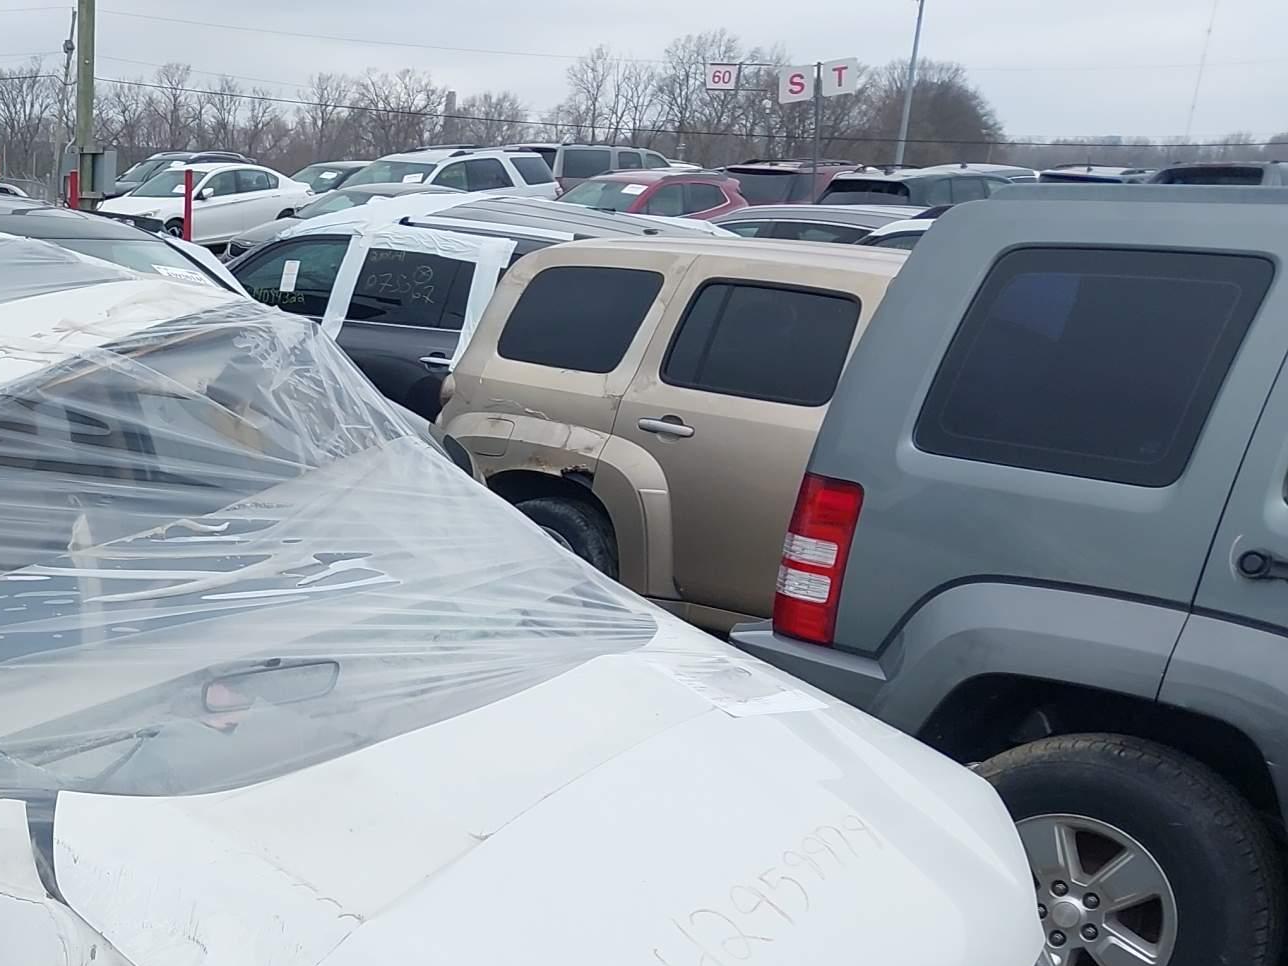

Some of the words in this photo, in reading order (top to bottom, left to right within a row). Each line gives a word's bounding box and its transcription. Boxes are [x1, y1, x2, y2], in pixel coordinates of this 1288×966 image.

[711, 70, 732, 85] 60
[788, 73, 806, 95] S
[831, 66, 849, 87] T
